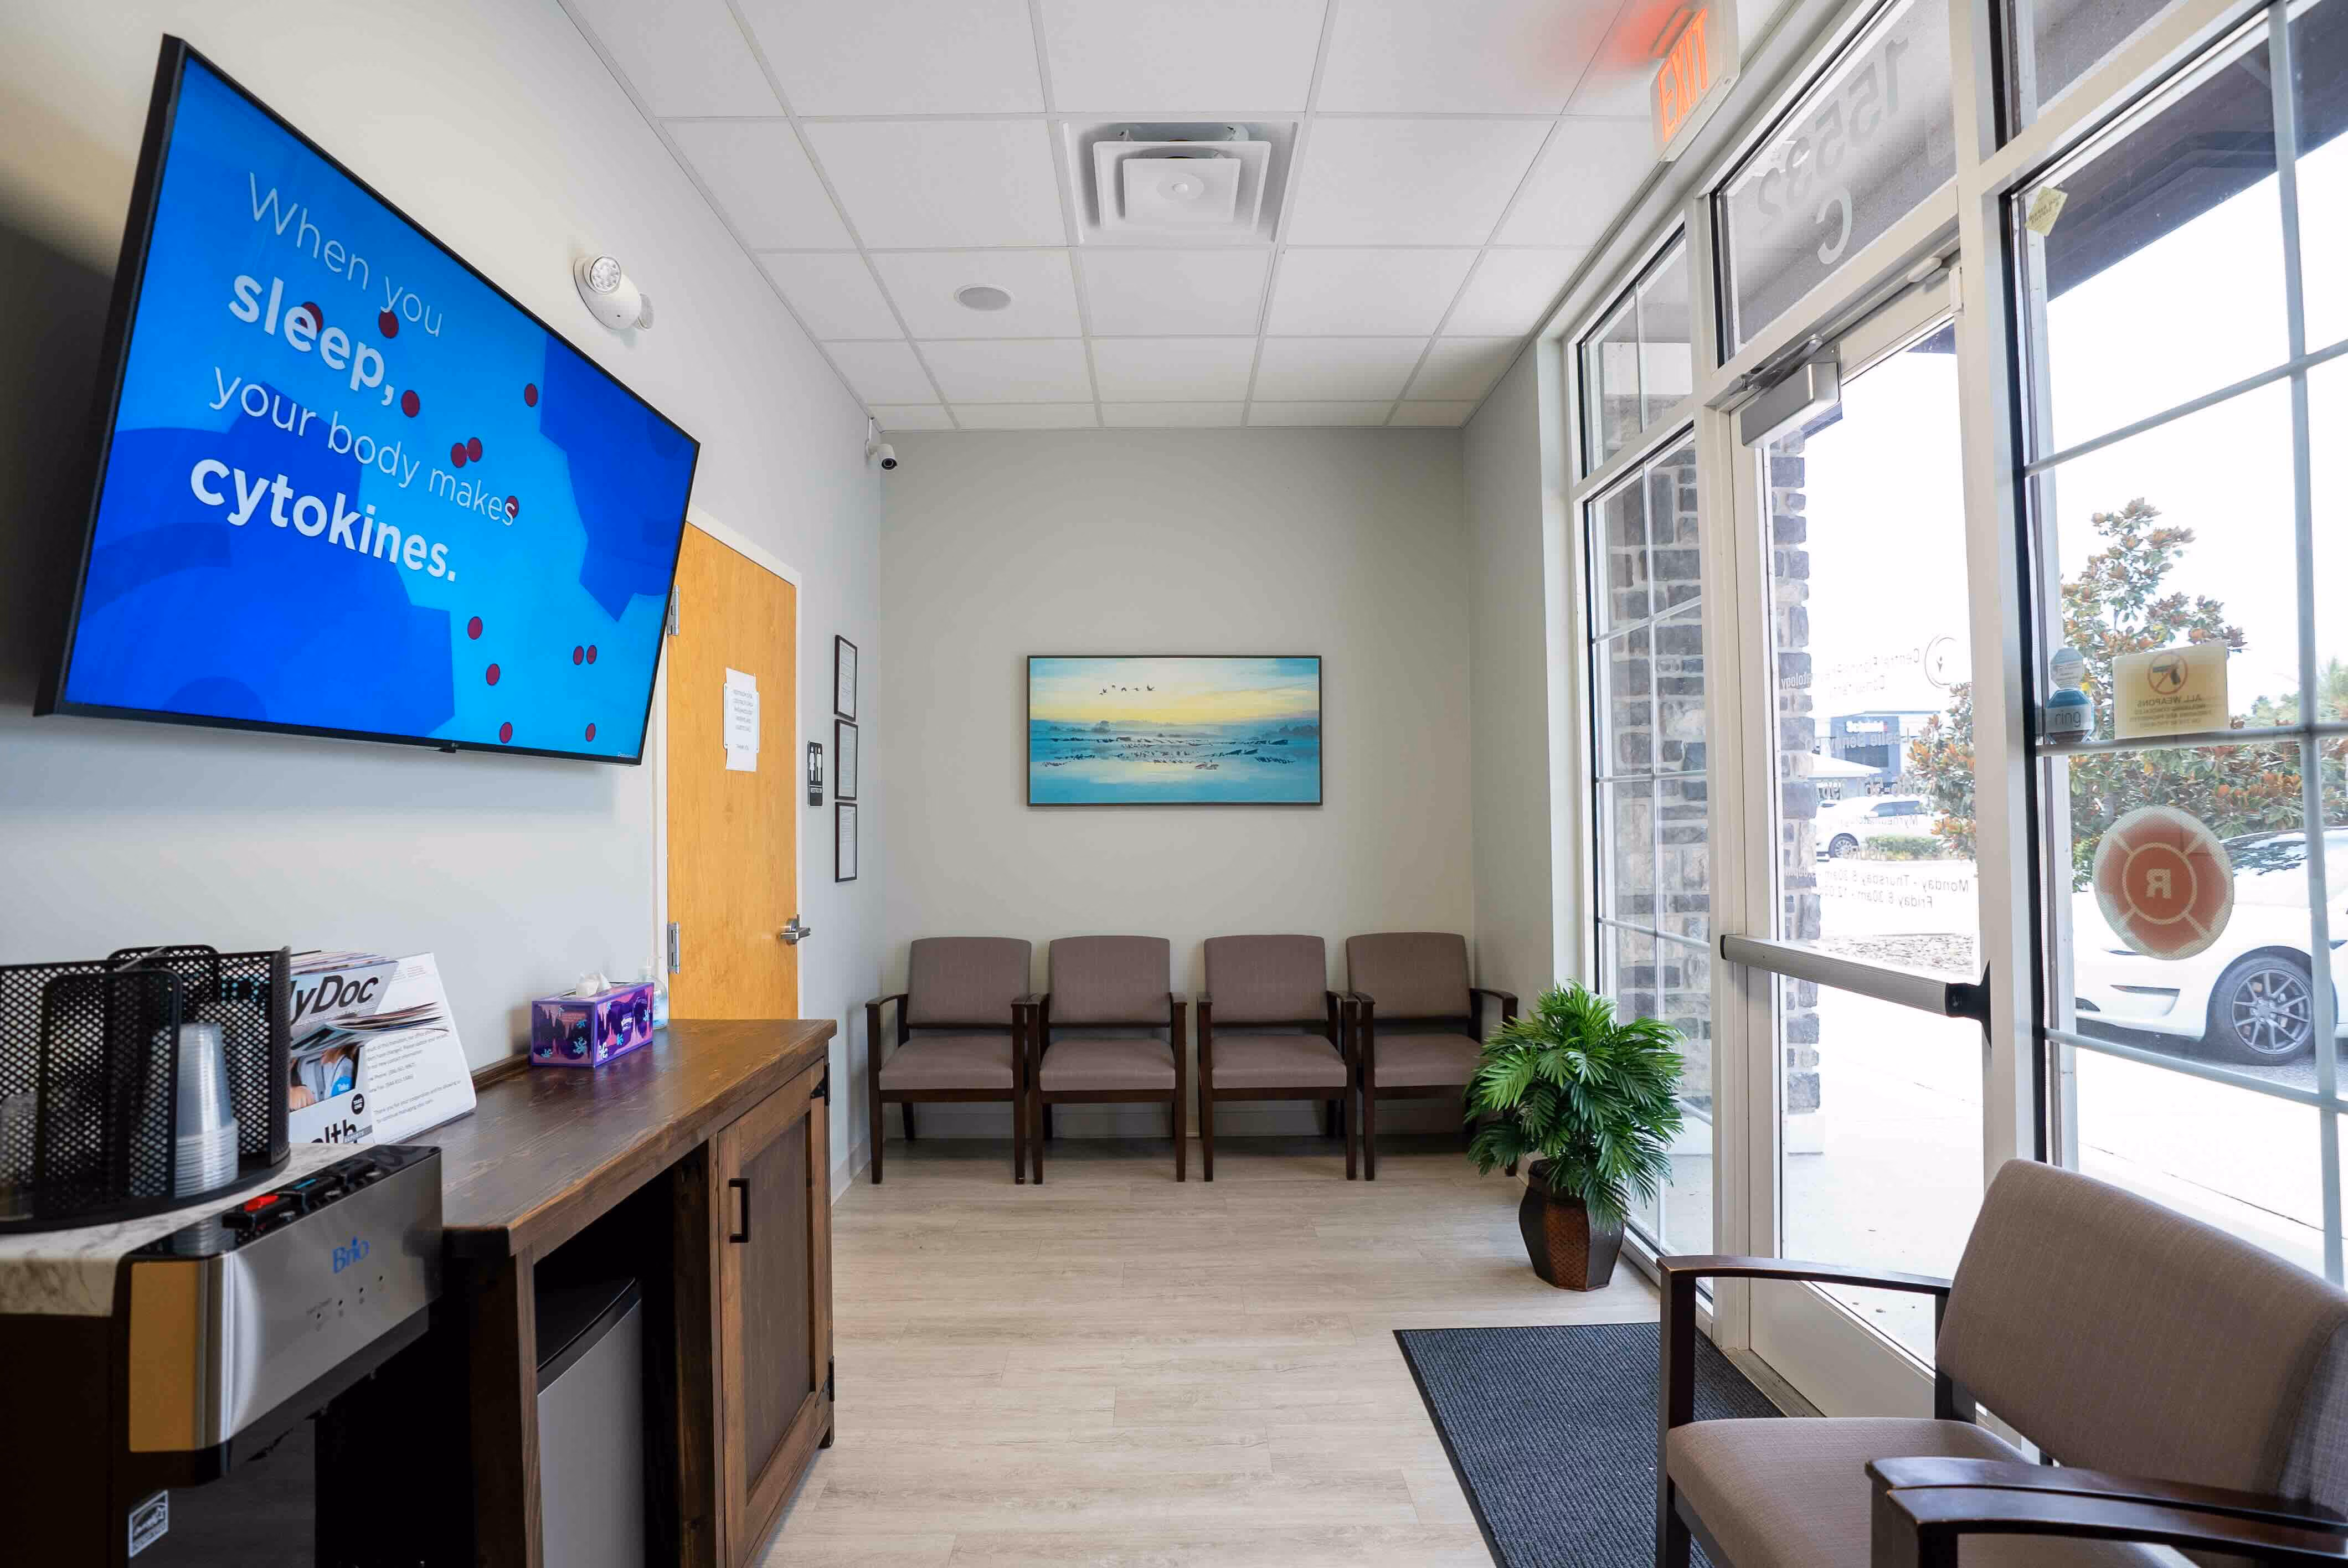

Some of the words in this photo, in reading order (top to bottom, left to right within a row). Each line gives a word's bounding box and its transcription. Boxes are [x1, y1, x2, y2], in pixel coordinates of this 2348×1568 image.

[1657, 8, 1707, 142] EXIT
[249, 172, 369, 290] When
[380, 276, 442, 337] you
[228, 275, 395, 405] sleep,
[208, 366, 317, 436] your
[328, 411, 420, 488] body
[428, 467, 515, 525] makes
[190, 458, 456, 582] cytokines.
[2054, 710, 2082, 728] ring
